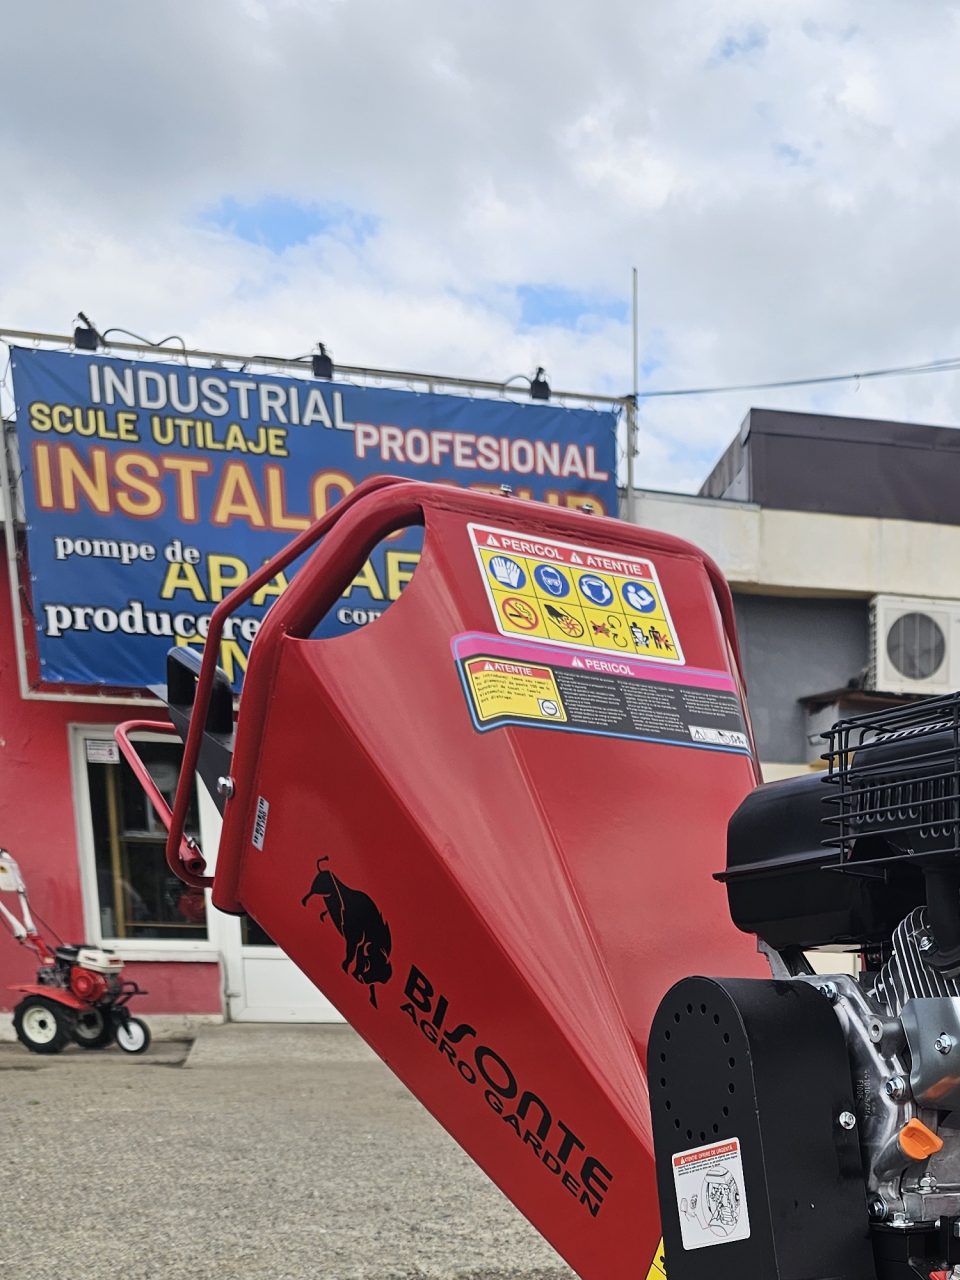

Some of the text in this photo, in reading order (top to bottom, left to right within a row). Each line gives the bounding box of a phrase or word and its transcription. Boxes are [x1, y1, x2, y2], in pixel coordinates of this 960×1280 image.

[89, 363, 357, 430] INDUSTRIAL
[29, 402, 290, 457] SCULE UTILAJE
[354, 424, 609, 481] PROFESIONAL
[55, 536, 201, 564] pompe de
[501, 537, 563, 560] PERICOL
[585, 658, 634, 676] PERICOL
[400, 1003, 604, 1217] AGRO GARDEN
[404, 964, 613, 1201] BISONTE
